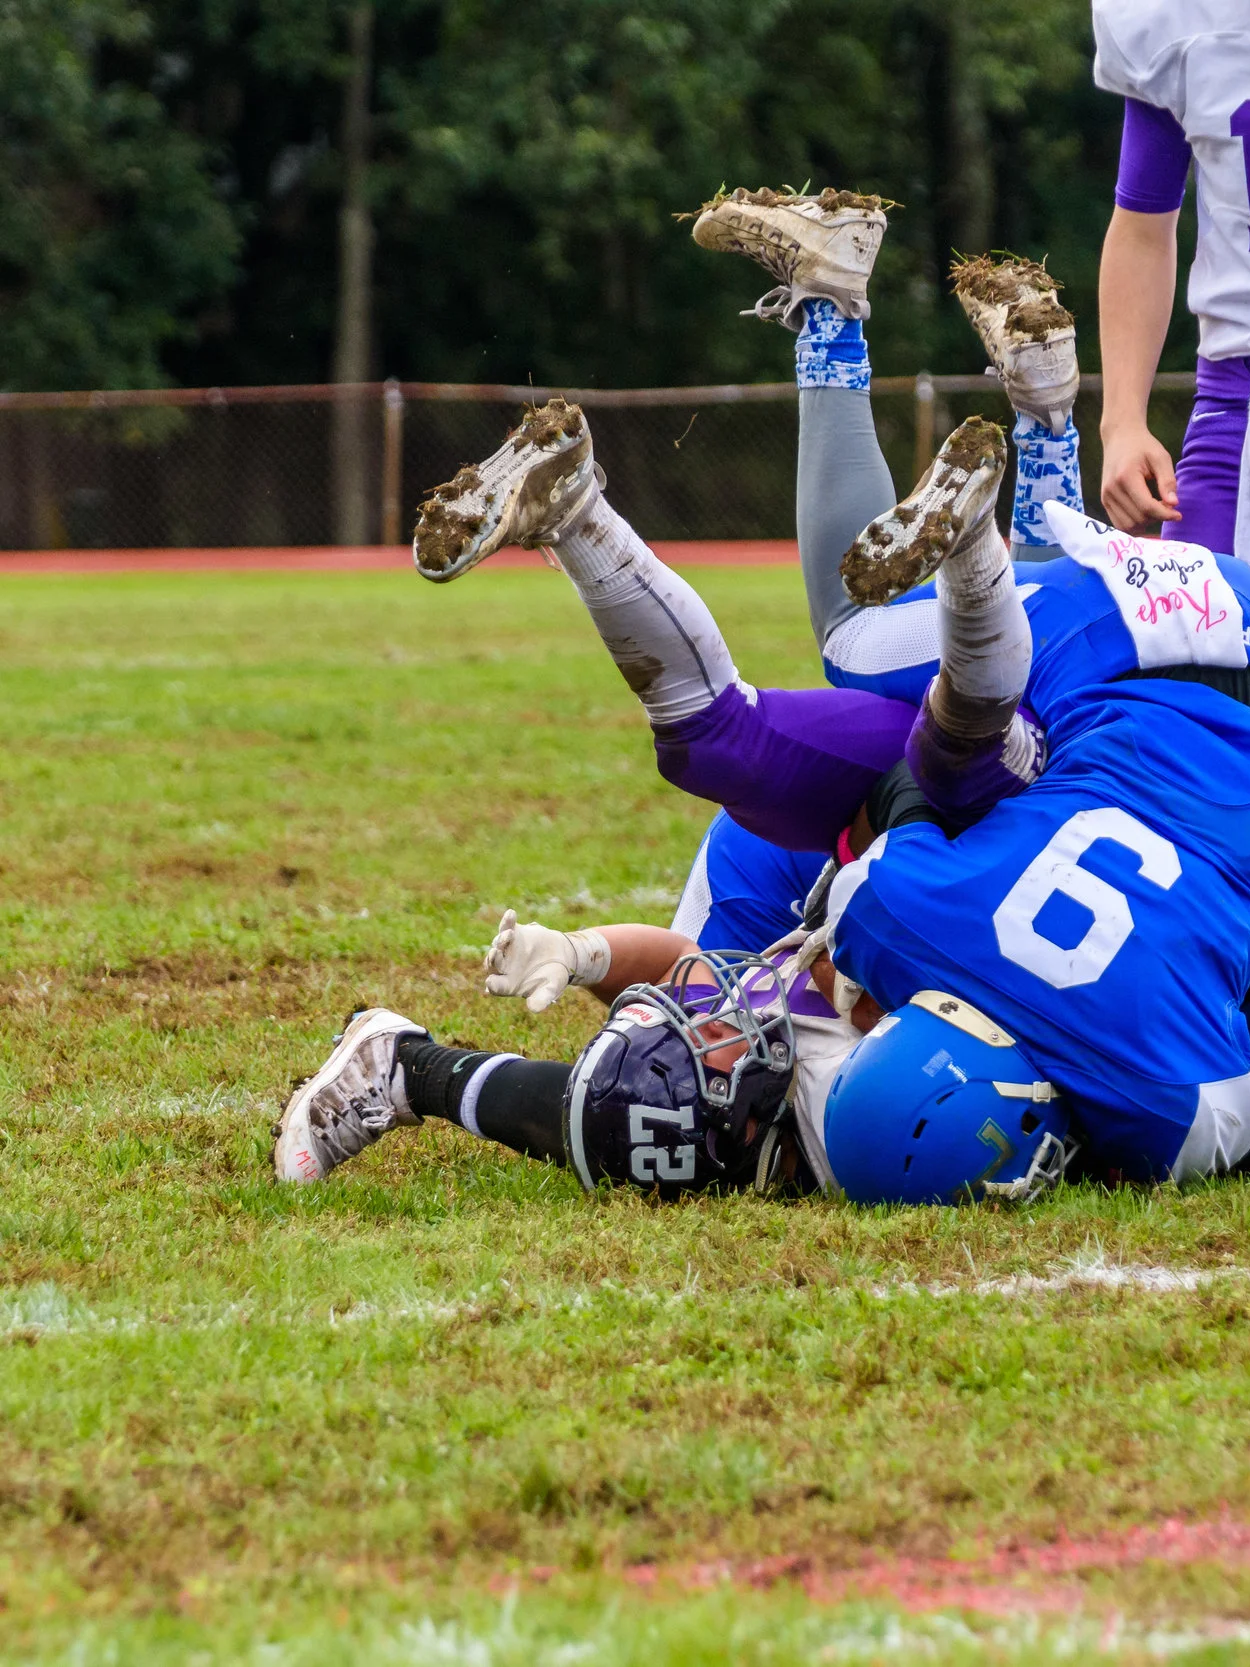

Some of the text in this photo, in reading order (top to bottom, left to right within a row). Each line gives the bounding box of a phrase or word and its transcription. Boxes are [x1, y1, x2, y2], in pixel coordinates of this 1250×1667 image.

[1153, 558, 1204, 585] calm
[1136, 579, 1228, 632] Keep
[629, 1104, 696, 1181] 27
